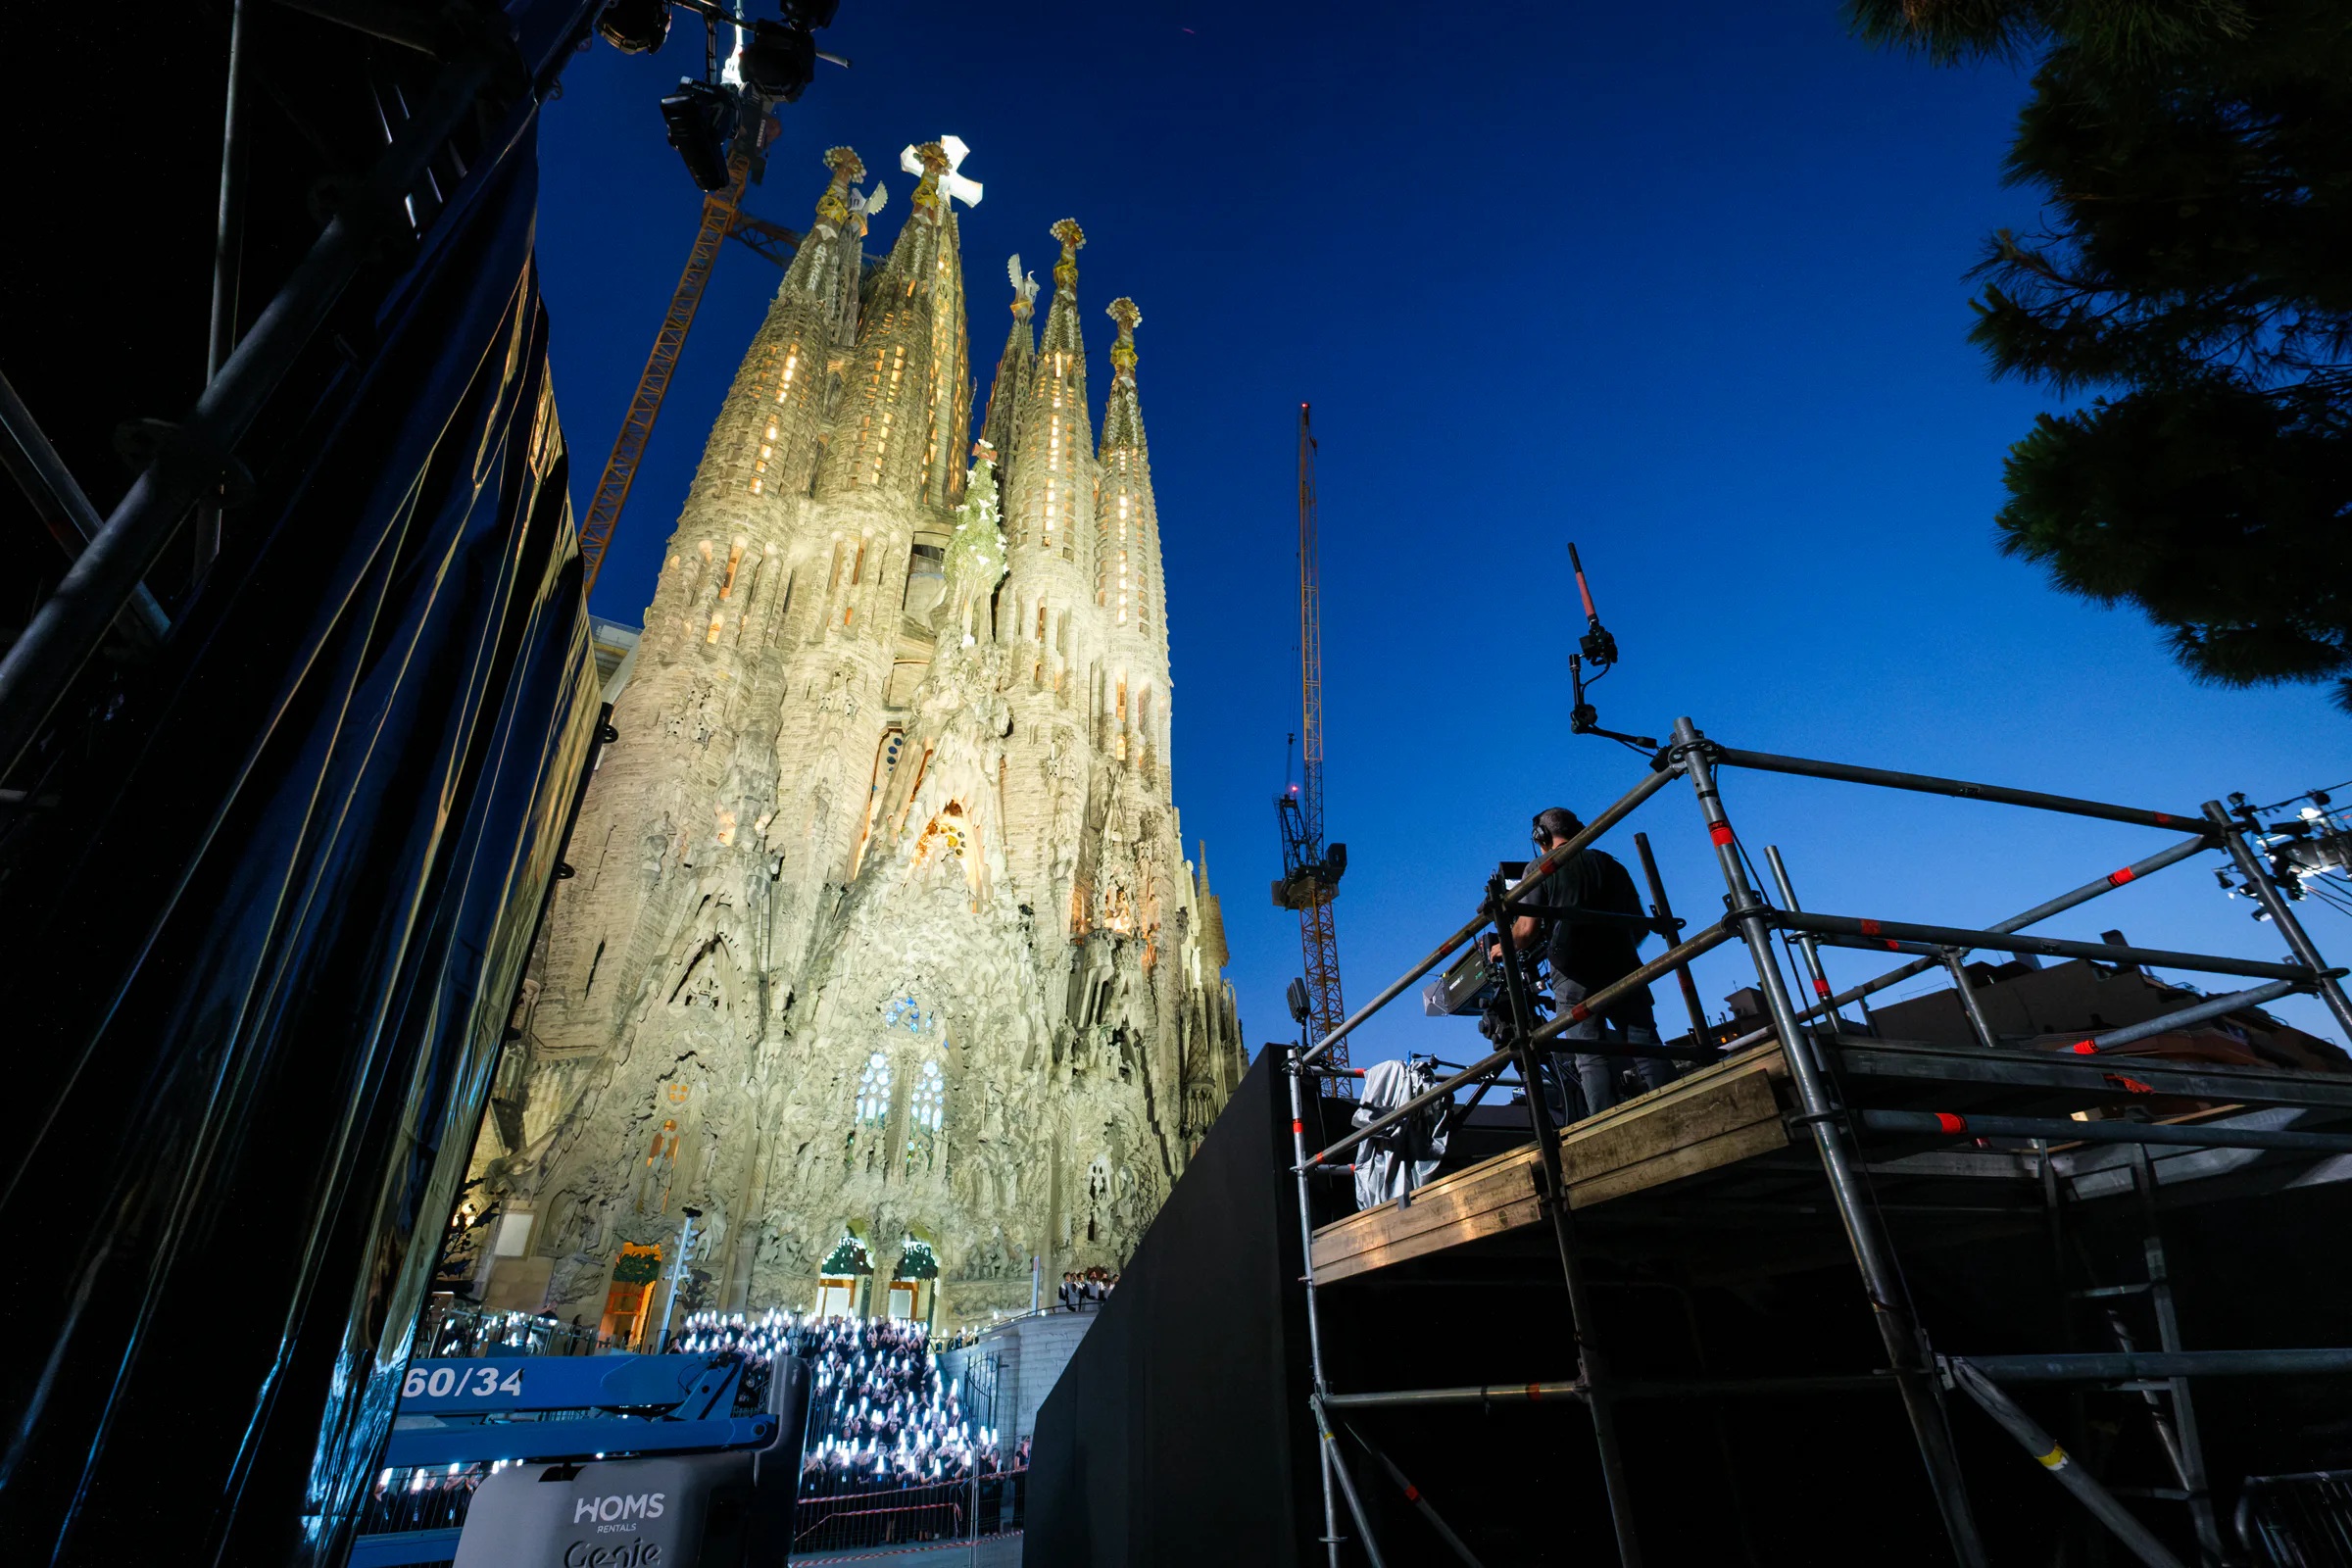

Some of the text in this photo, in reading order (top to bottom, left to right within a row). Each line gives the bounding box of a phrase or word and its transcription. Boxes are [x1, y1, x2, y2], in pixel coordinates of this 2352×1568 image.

[402, 1367, 523, 1398] 60/34
[573, 1493, 665, 1524] HOMS
[596, 1522, 637, 1534] RENTALS
[564, 1537, 662, 1568] Genie
